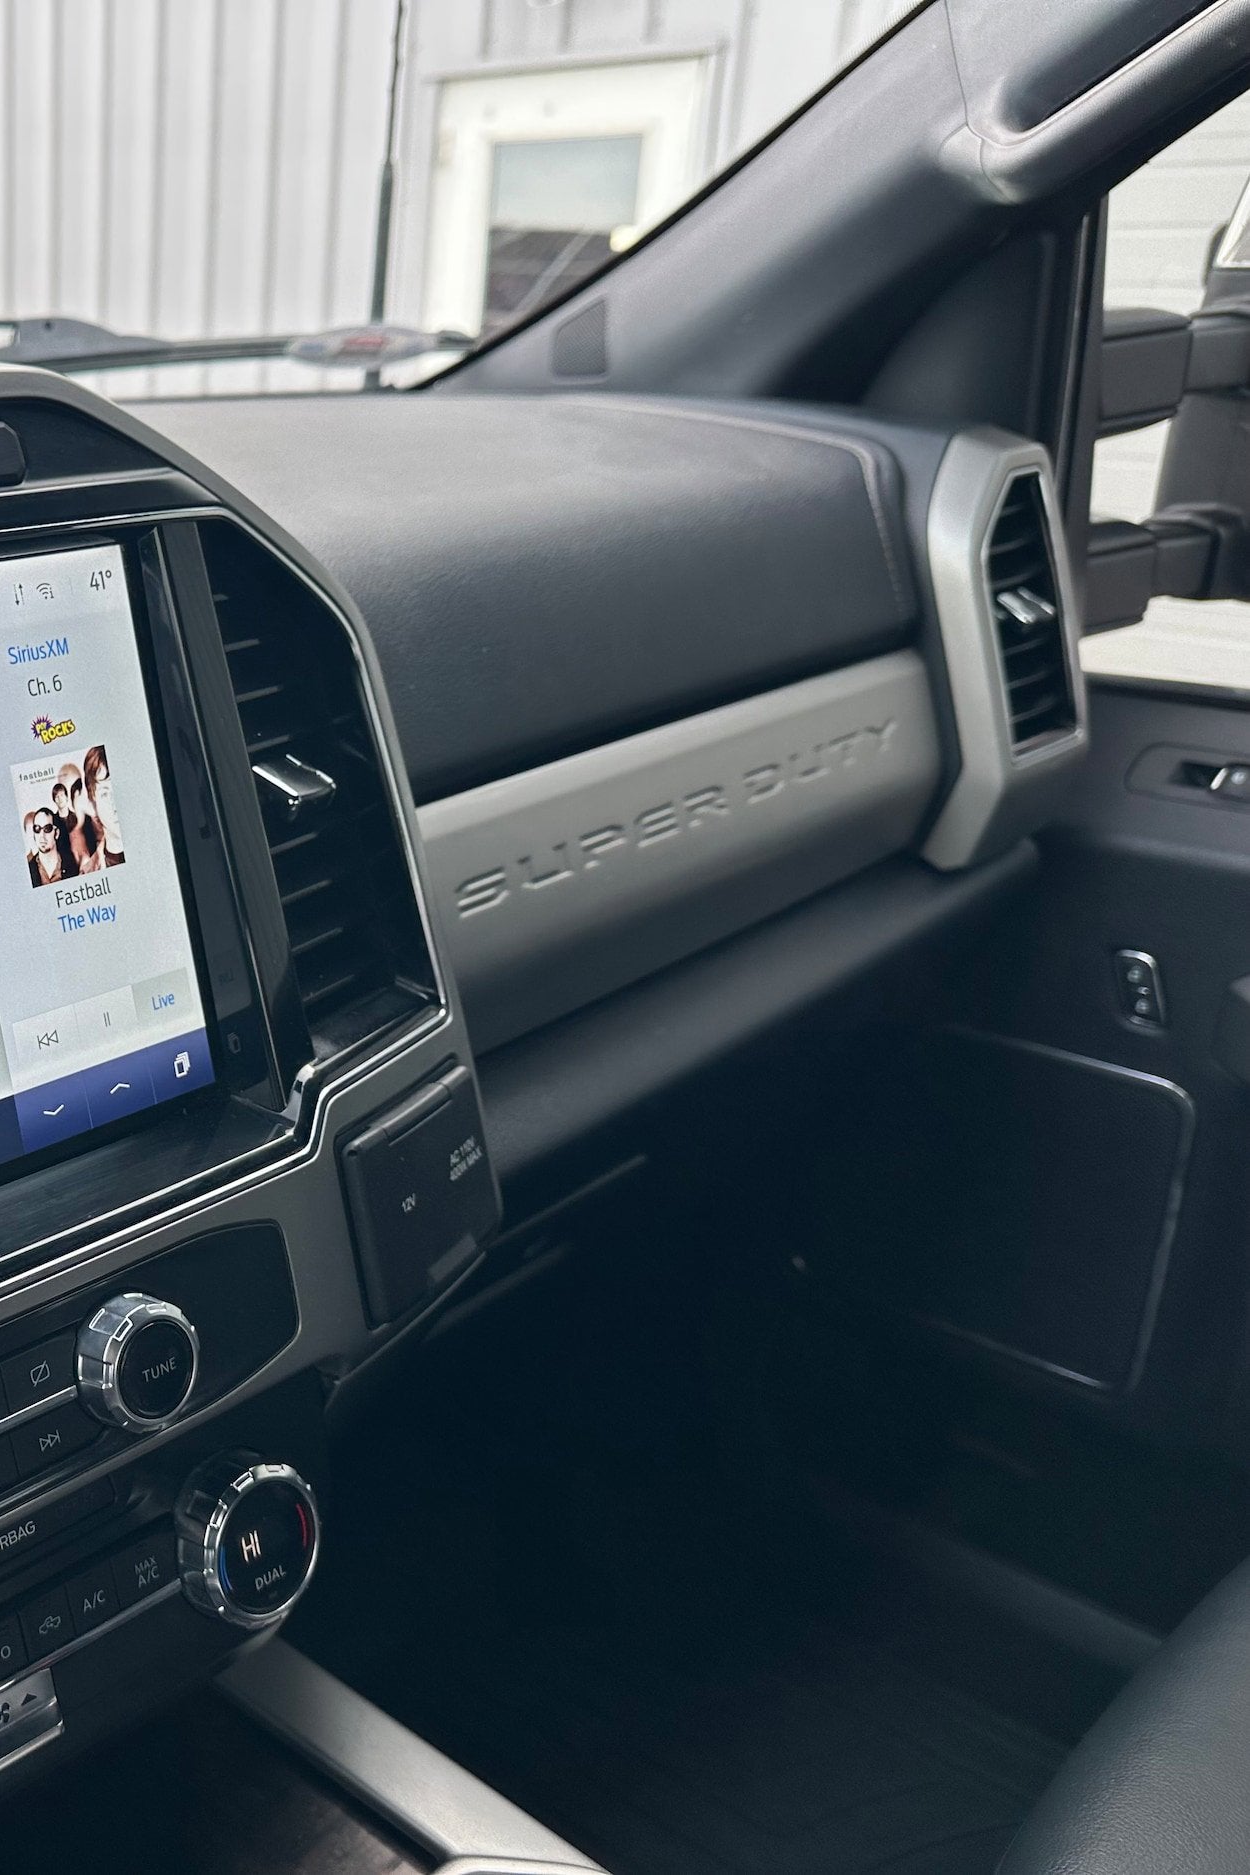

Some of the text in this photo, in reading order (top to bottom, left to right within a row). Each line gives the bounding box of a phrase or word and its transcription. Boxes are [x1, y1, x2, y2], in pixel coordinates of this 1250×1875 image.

[90, 570, 112, 591] 41°
[8, 638, 69, 664] SiriusXM
[28, 675, 62, 696] Ch. 6
[40, 720, 75, 744] ROCKS
[19, 767, 54, 781] fastball
[455, 719, 897, 919] SUPER DUTY
[56, 877, 112, 908] Fastball
[58, 905, 117, 933] The Way
[152, 992, 175, 1011] Live
[401, 1193, 416, 1213] 12V
[141, 1356, 177, 1383] TUNE
[241, 1530, 262, 1562] HI
[134, 1555, 158, 1574] MAX
[138, 1565, 160, 1588] A/C
[254, 1565, 287, 1591] DUAL
[83, 1589, 106, 1613] A/C
